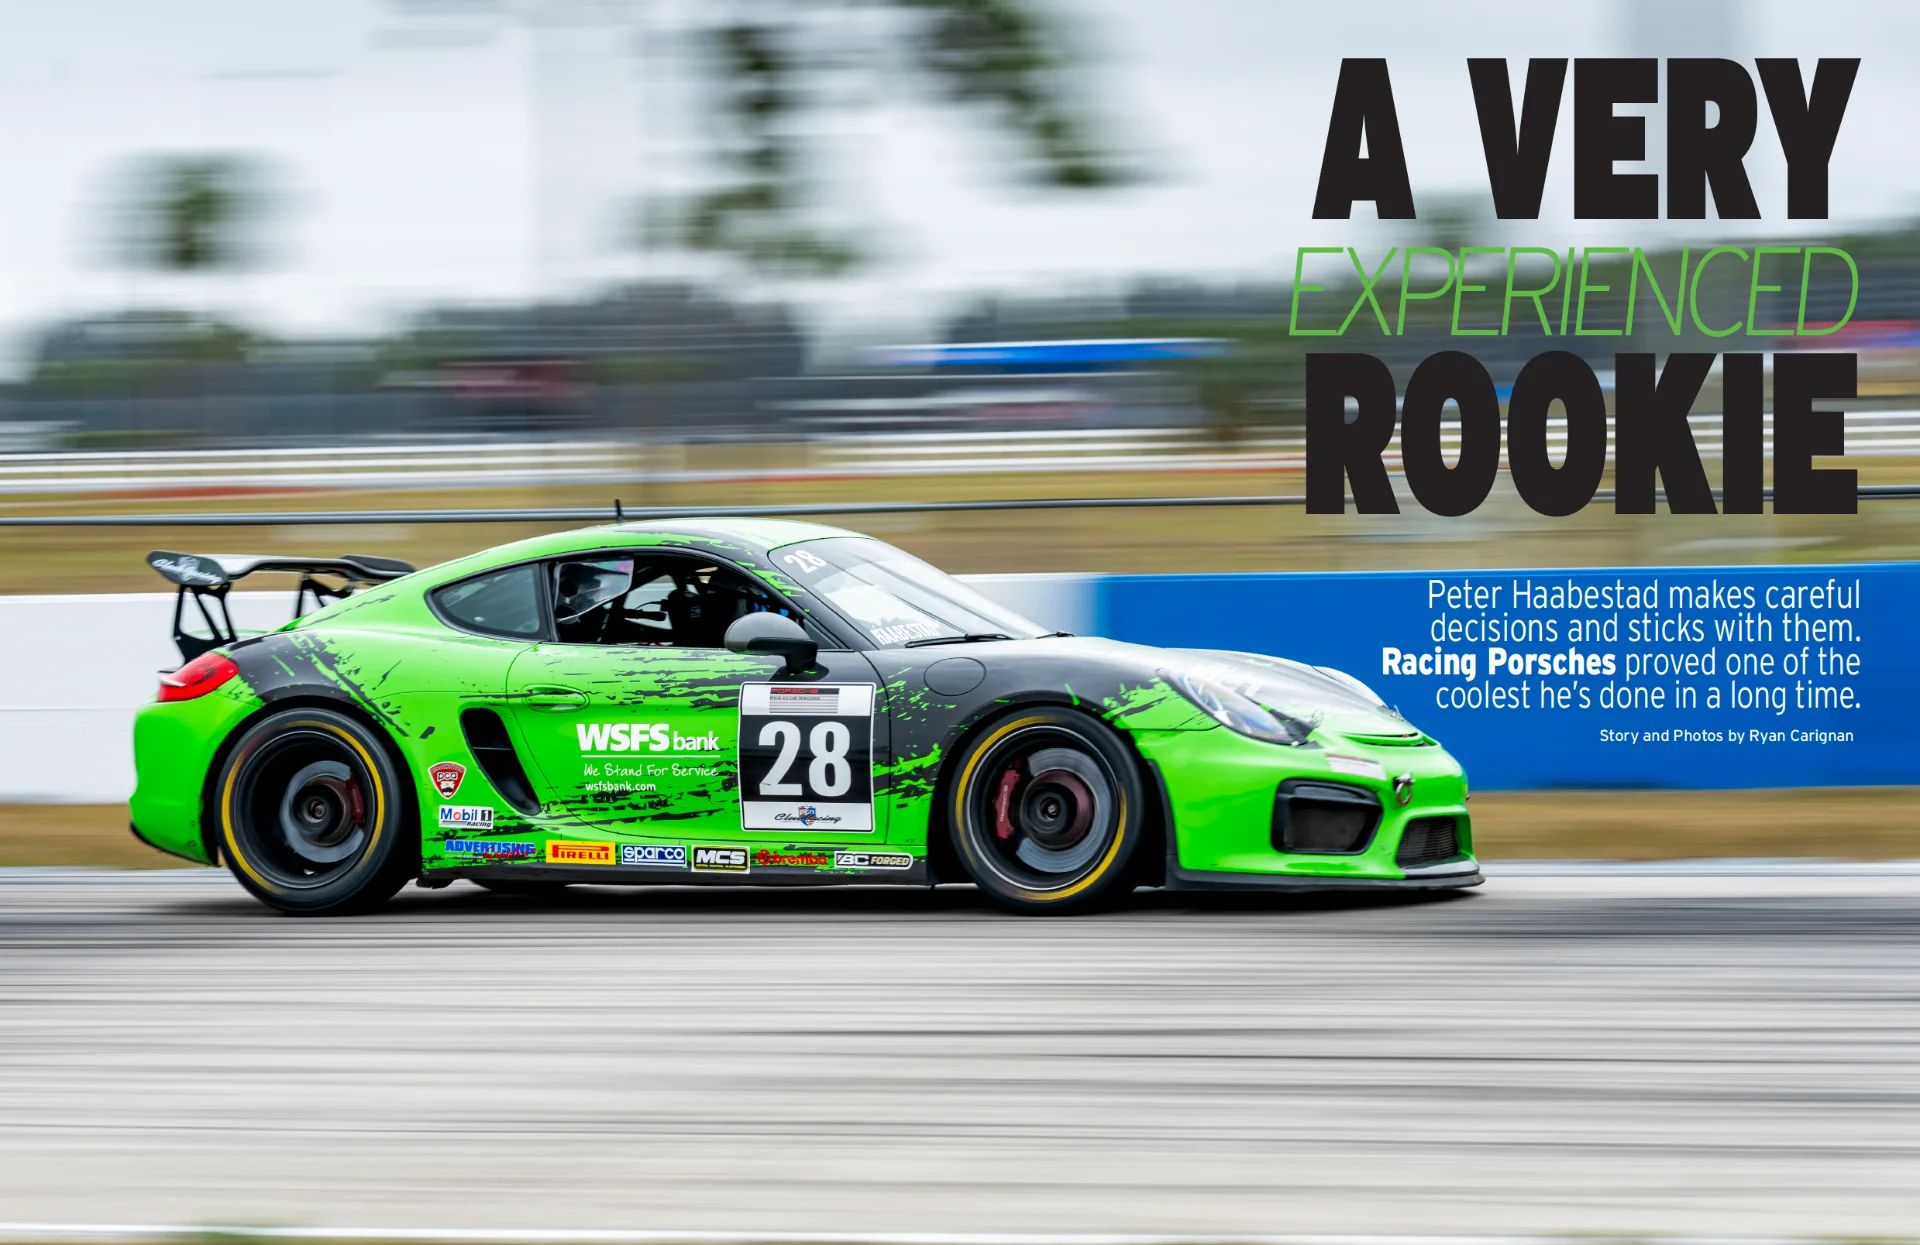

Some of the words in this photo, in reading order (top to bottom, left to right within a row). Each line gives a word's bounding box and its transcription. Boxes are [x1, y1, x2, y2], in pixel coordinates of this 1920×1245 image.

[783, 549, 828, 574] 28
[576, 723, 670, 752] WSFS
[673, 730, 720, 751] bank
[758, 721, 852, 797] 28
[583, 763, 601, 777] We
[604, 762, 643, 777] Stand
[646, 764, 668, 777] For
[671, 763, 718, 777] Service
[585, 780, 656, 792] wsfsbank.com
[441, 808, 478, 821] Mobil
[481, 810, 492, 821] 1
[445, 840, 535, 855] ADVERTISING
[552, 845, 609, 860] PIRELLI
[623, 847, 685, 863] sparco
[696, 849, 746, 865] MCS
[772, 851, 827, 866] brembo
[870, 856, 910, 866] FORGED
